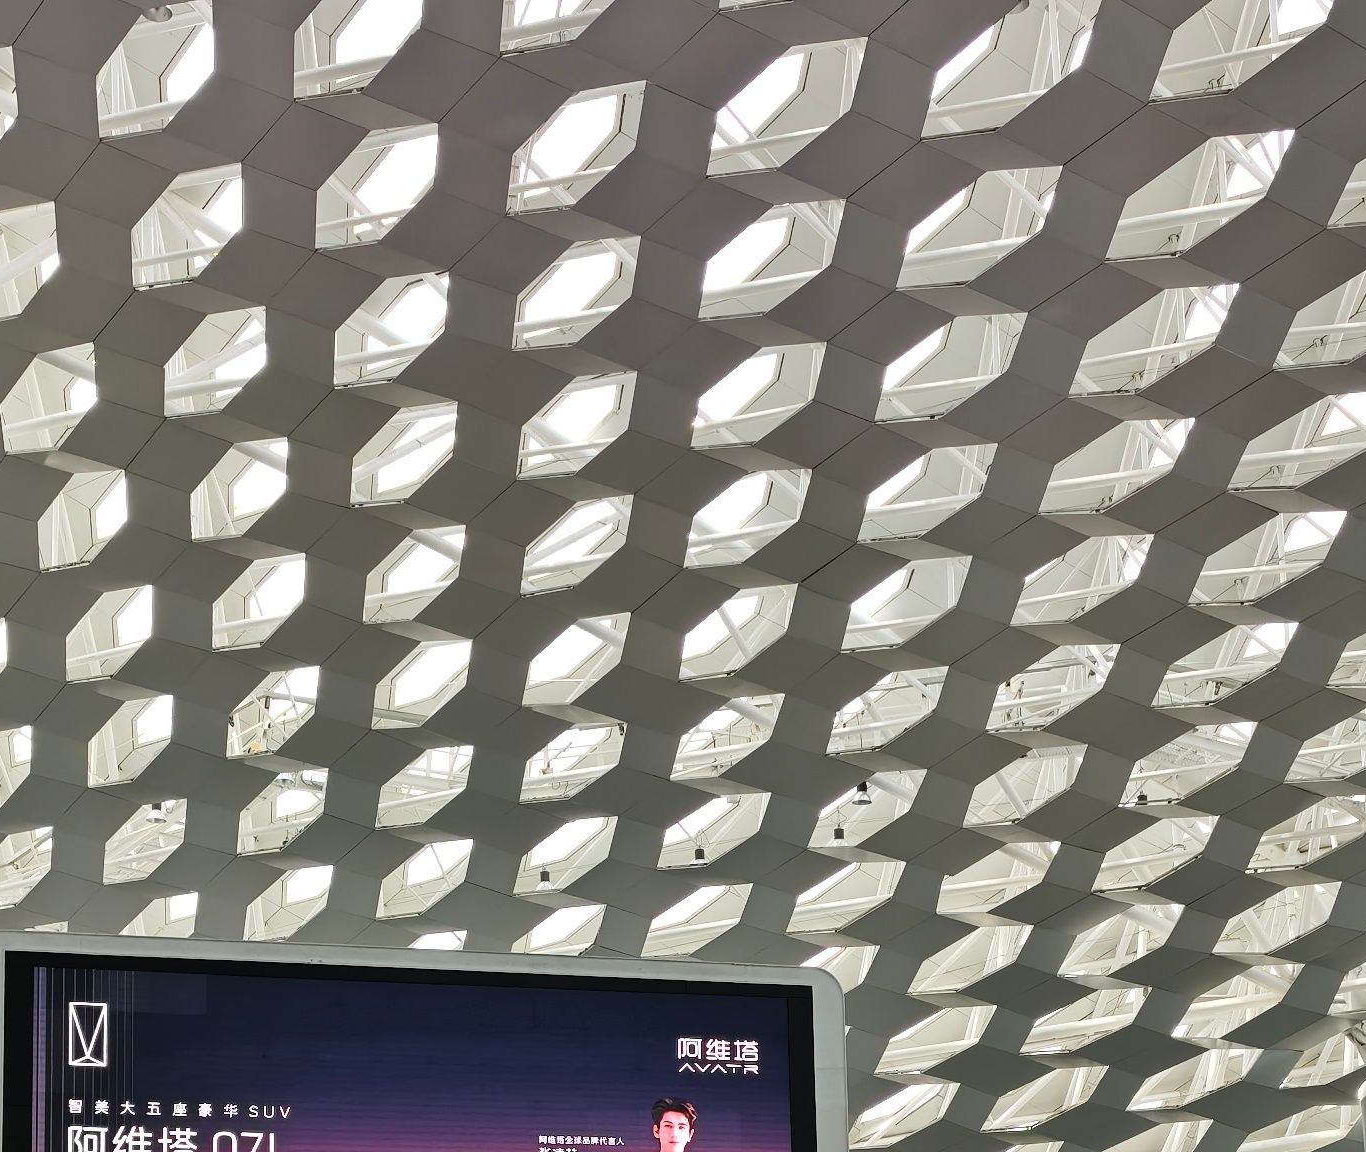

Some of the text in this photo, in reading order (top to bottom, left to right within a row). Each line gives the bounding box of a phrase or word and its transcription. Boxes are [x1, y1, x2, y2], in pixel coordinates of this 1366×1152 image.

[677, 1037, 759, 1062] 阿维塔
[678, 1062, 759, 1075] AVATR
[68, 1099, 292, 1119] 智美大五座豪华 SUV
